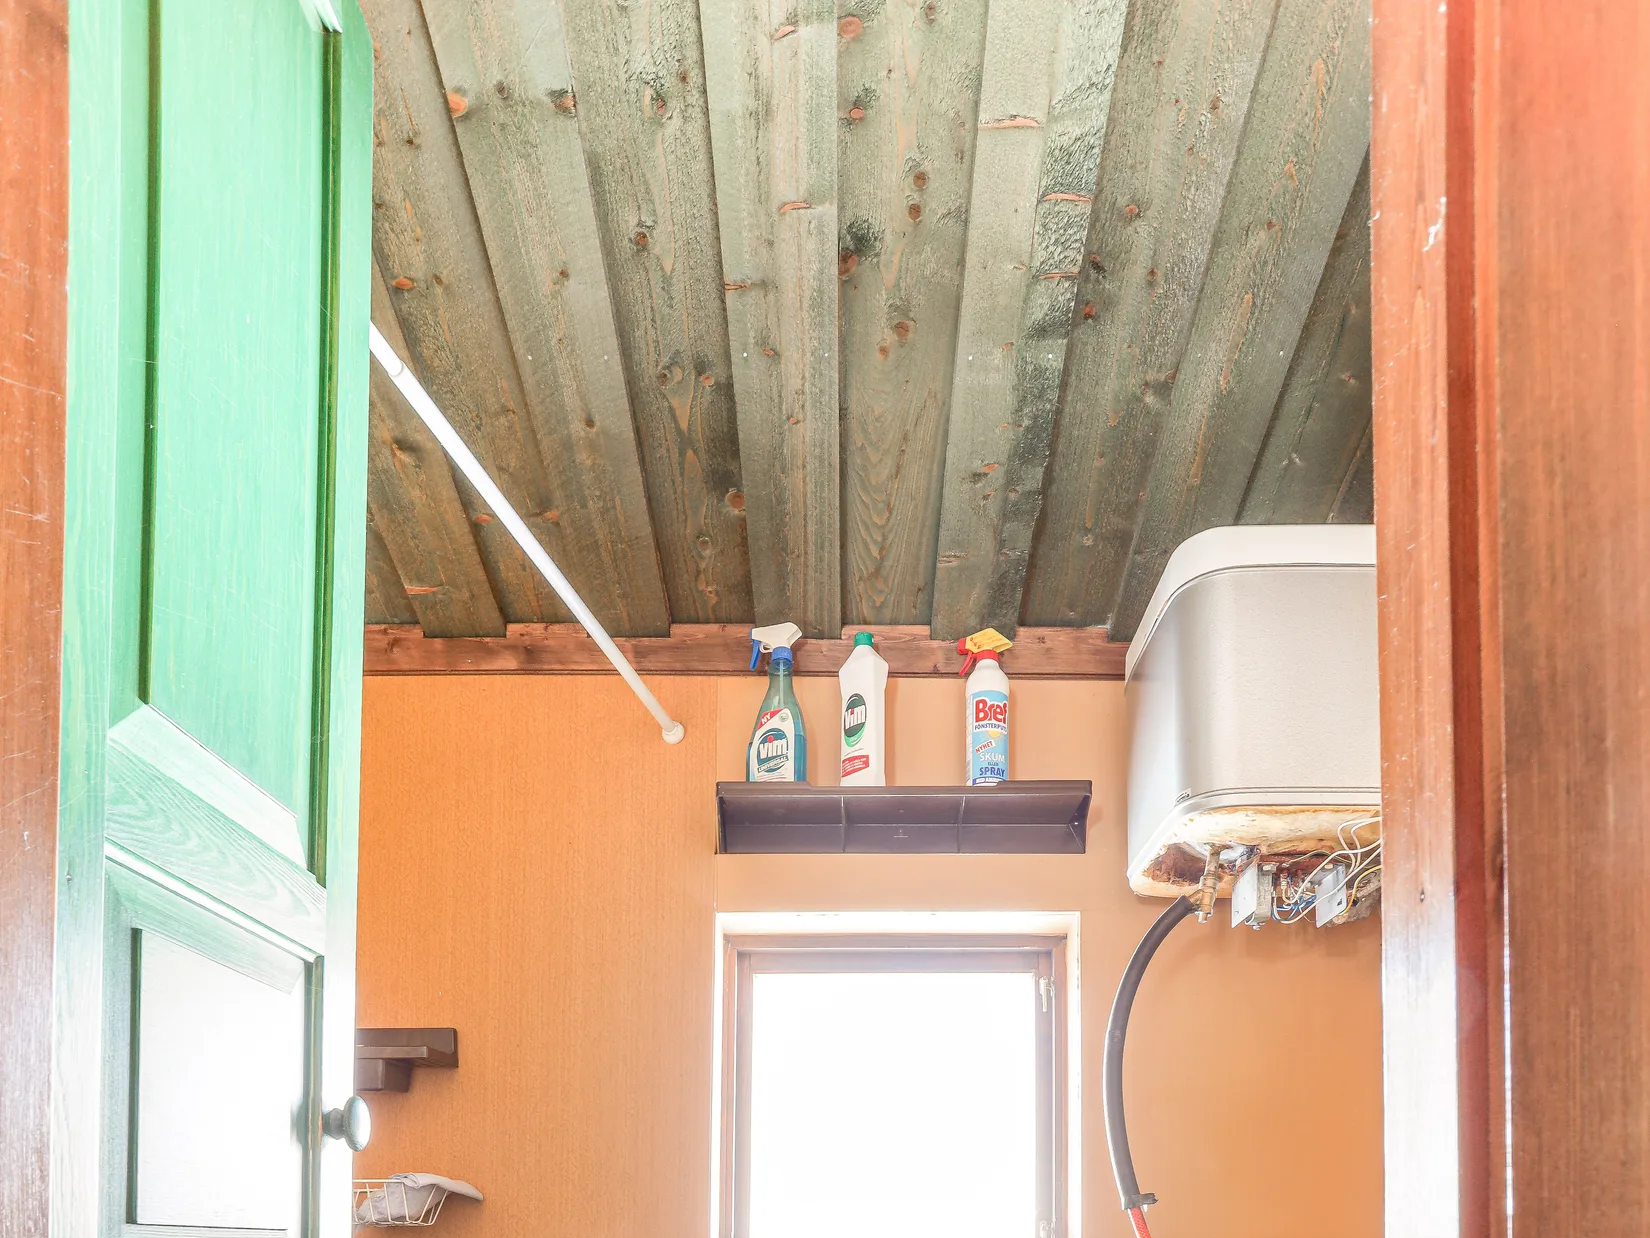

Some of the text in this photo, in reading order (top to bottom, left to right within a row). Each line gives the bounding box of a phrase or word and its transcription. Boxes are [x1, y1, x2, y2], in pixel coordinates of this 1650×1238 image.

[975, 698, 1007, 724] Bref
[761, 712, 771, 725] NY
[975, 740, 993, 753] NYHET
[980, 752, 1005, 763] SKUM
[979, 766, 1005, 777] SPRAY
